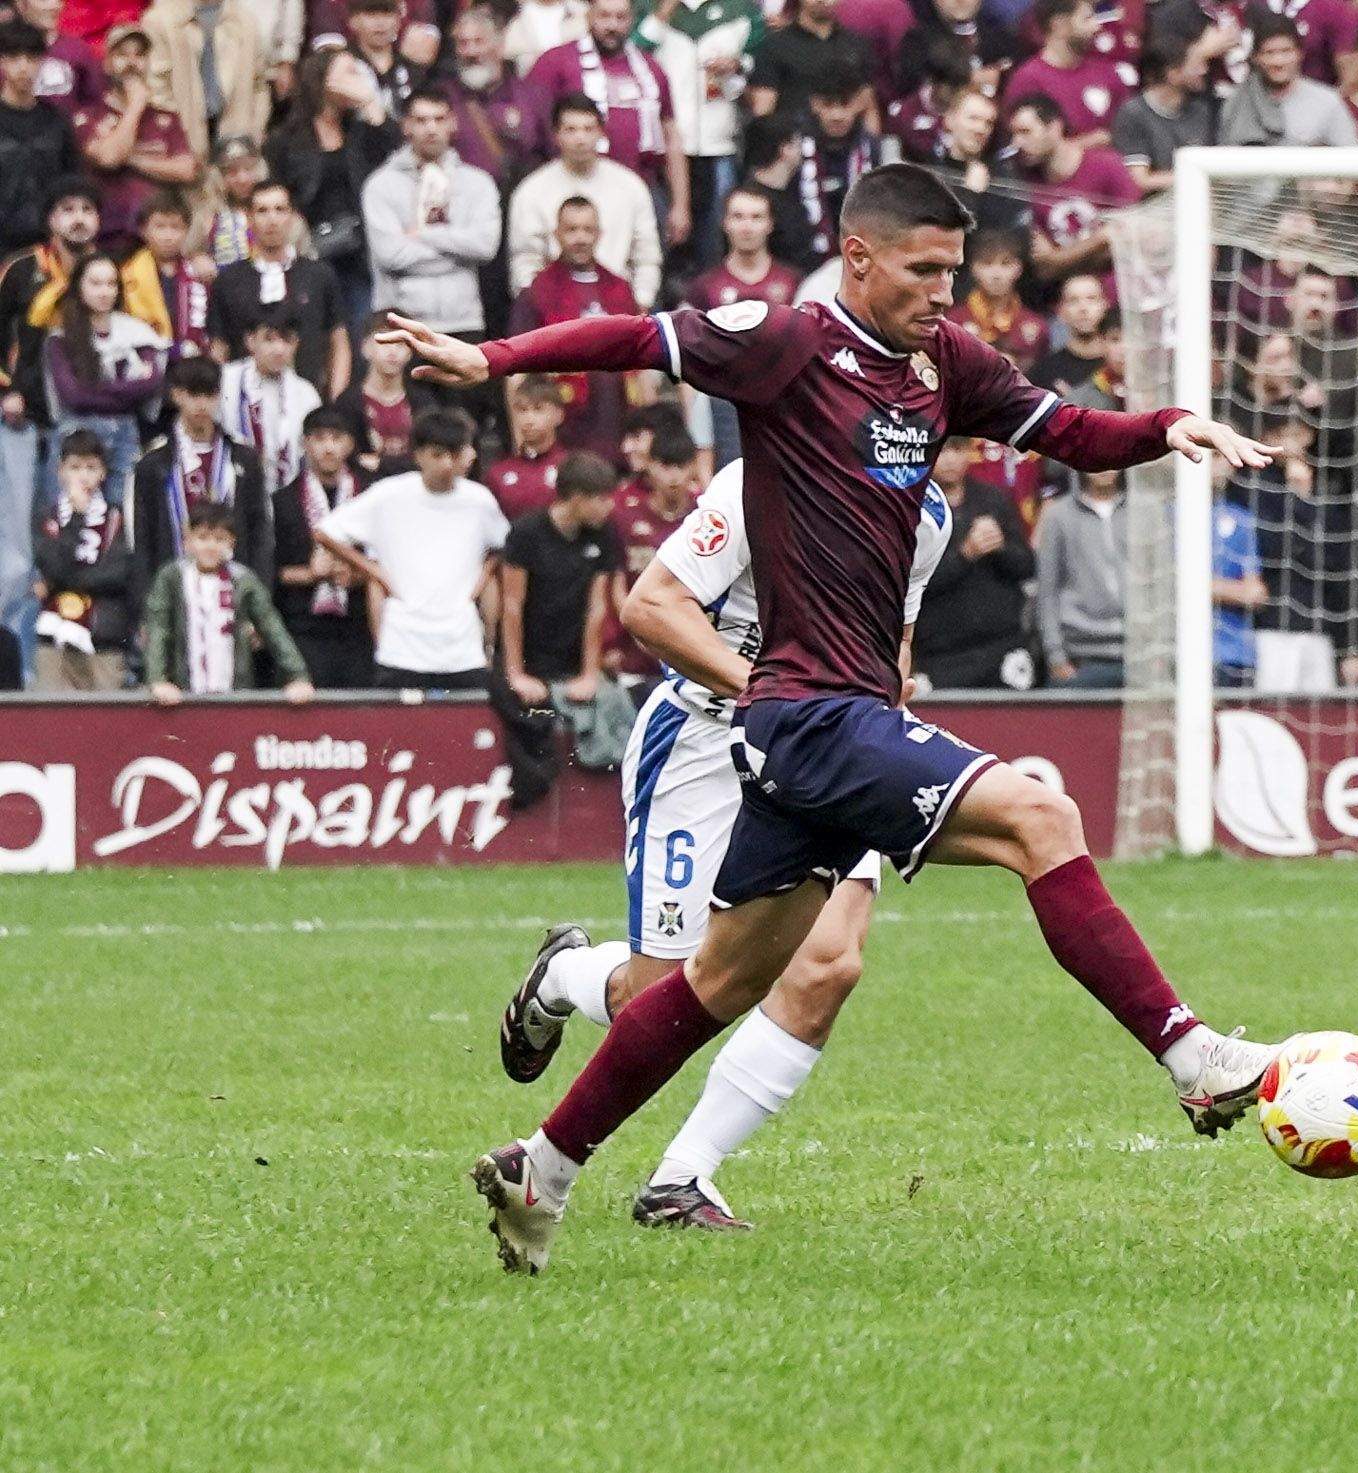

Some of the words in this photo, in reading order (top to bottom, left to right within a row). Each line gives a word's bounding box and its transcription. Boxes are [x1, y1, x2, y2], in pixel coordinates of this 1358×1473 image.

[254, 733, 368, 770] tiendas
[94, 751, 514, 870] Dispaint
[664, 829, 695, 889] 6
